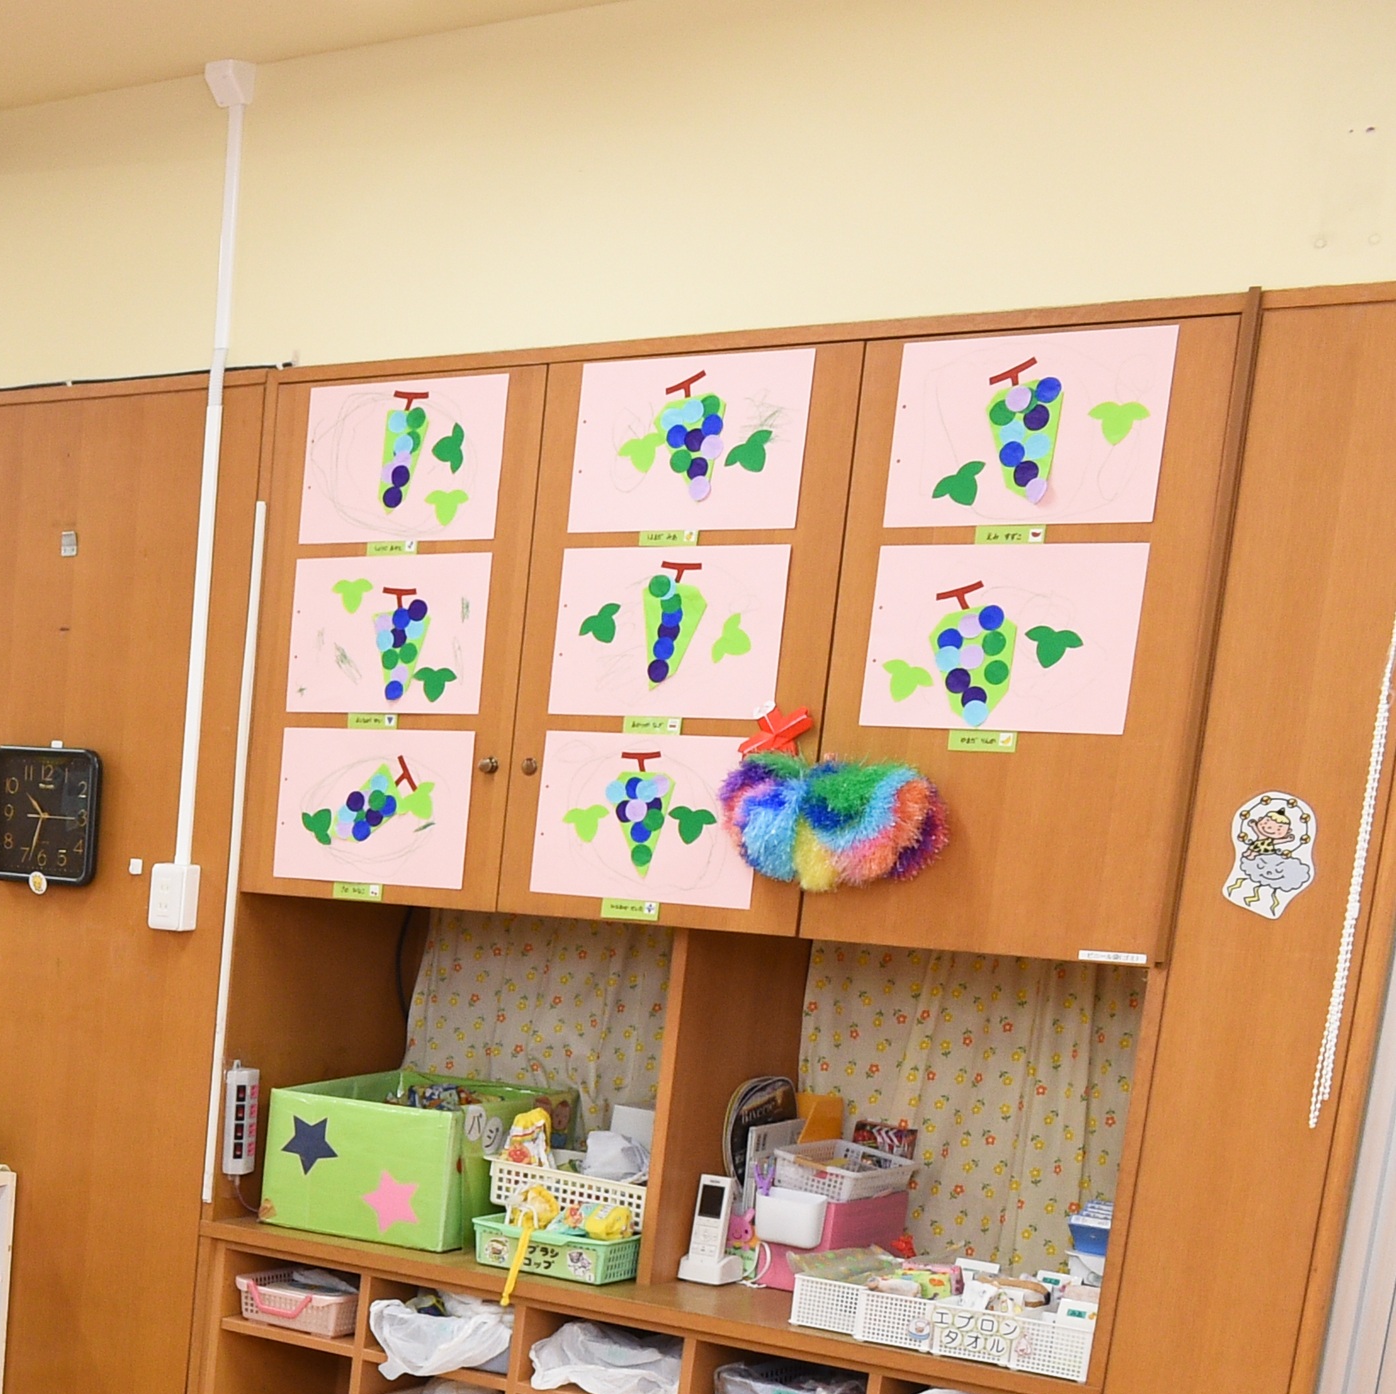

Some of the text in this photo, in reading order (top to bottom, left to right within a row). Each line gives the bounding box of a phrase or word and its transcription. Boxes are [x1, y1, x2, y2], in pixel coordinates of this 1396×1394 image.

[24, 765, 34, 781] 11
[41, 764, 54, 782] 12
[5, 777, 20, 795] 10
[77, 781, 88, 798] 2
[3, 803, 15, 822] 9
[77, 809, 88, 827] 3
[3, 832, 14, 850] 8
[72, 839, 84, 856] 4
[20, 847, 31, 863] 7
[36, 849, 47, 867] 6
[57, 849, 68, 867] 5
[523, 1257, 555, 1270] コップ
[934, 1311, 1018, 1337] エプロン
[944, 1331, 1005, 1352] タオル
